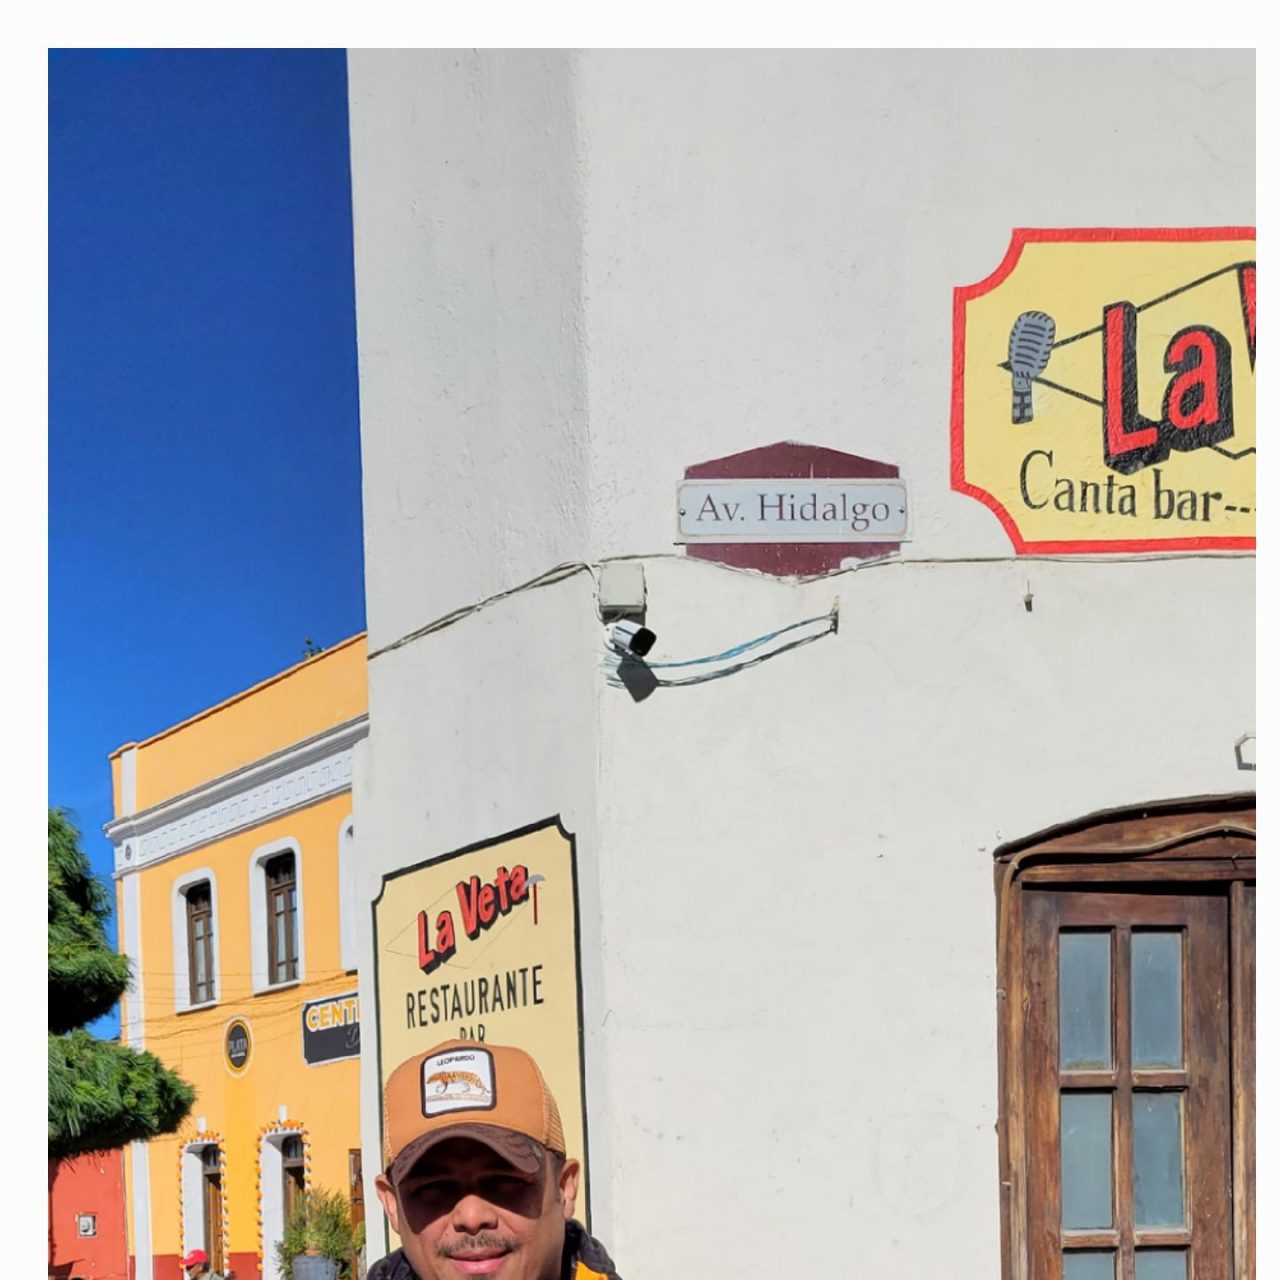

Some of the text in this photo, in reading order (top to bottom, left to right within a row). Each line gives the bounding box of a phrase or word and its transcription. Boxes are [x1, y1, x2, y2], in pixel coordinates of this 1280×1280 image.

[1103, 301, 1235, 475] La
[695, 492, 891, 532] Av. Hidalgo
[1019, 449, 1137, 518] Canta
[417, 864, 530, 976] La Veta
[306, 1000, 361, 1032] CENT
[405, 964, 545, 1029] RESTAURANTE
[436, 1054, 476, 1067] LEOPARDO
